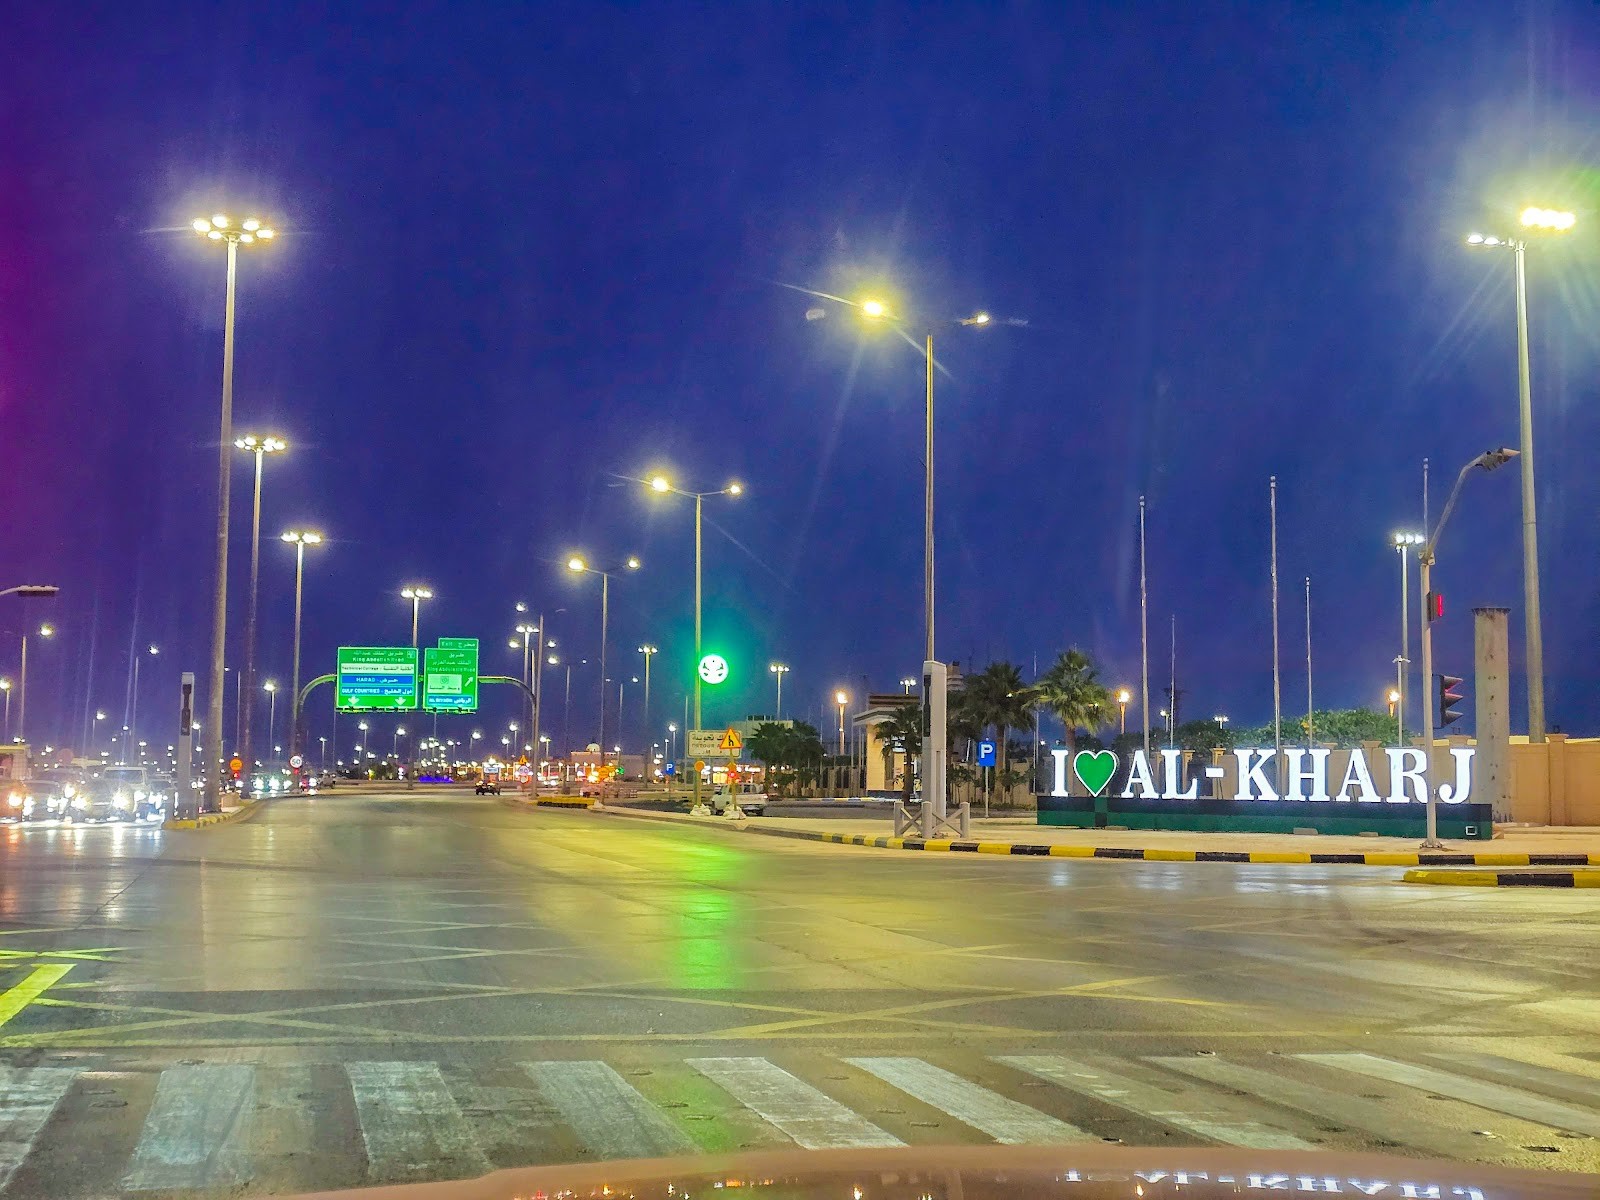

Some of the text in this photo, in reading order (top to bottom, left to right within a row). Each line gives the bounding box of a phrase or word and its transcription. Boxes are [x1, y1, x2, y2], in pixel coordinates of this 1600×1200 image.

[980, 743, 994, 759] P
[666, 763, 674, 771] P
[1050, 748, 1477, 805] I AL-KHARJ
